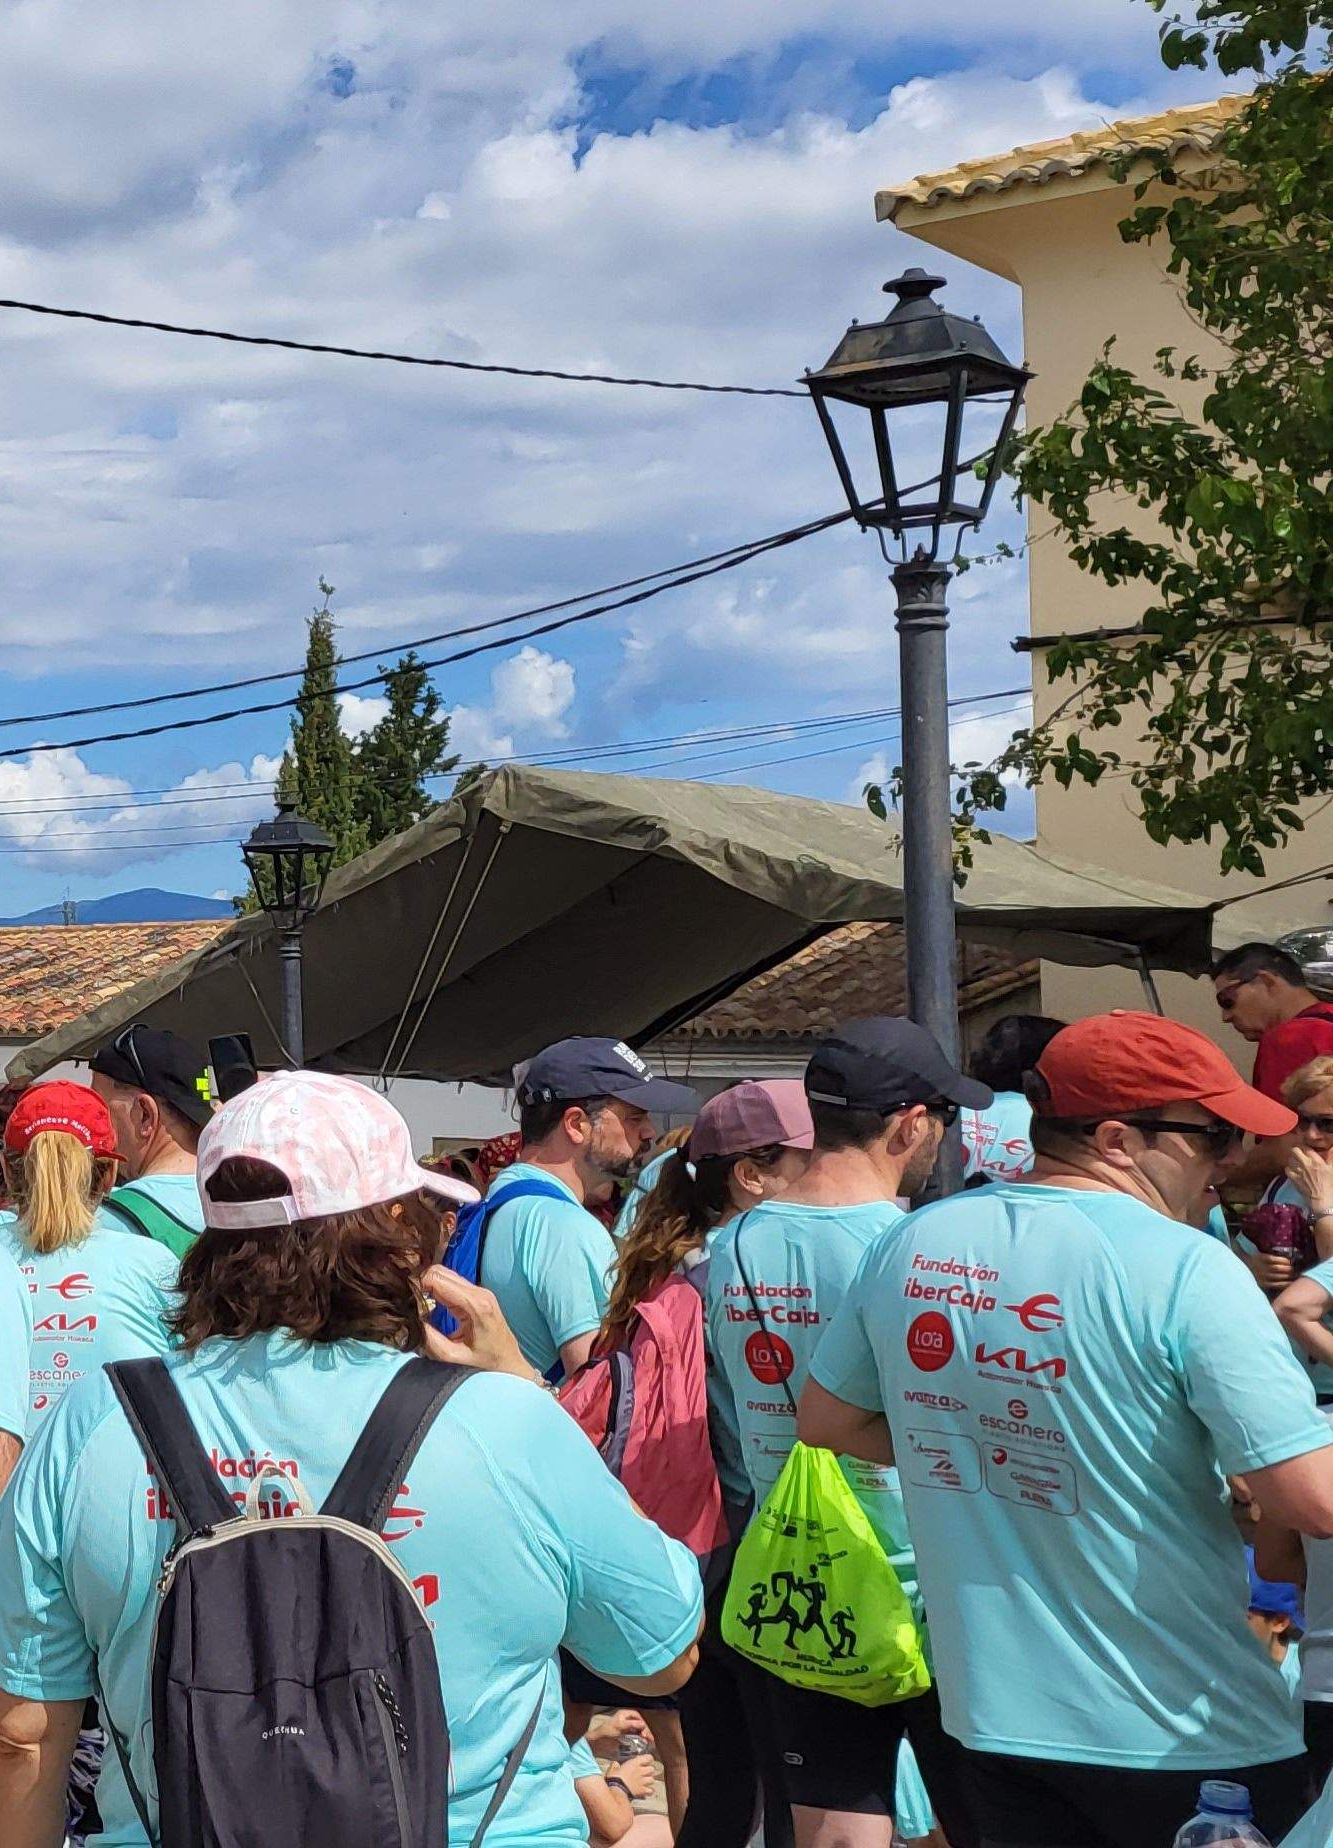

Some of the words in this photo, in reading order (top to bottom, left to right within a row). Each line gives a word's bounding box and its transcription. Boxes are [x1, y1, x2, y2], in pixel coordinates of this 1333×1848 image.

[911, 1254, 1000, 1282] Fundación
[904, 1277, 997, 1315] iberCaja
[979, 1413, 1066, 1444] escanero
[262, 1725, 305, 1740] QUECHUA
